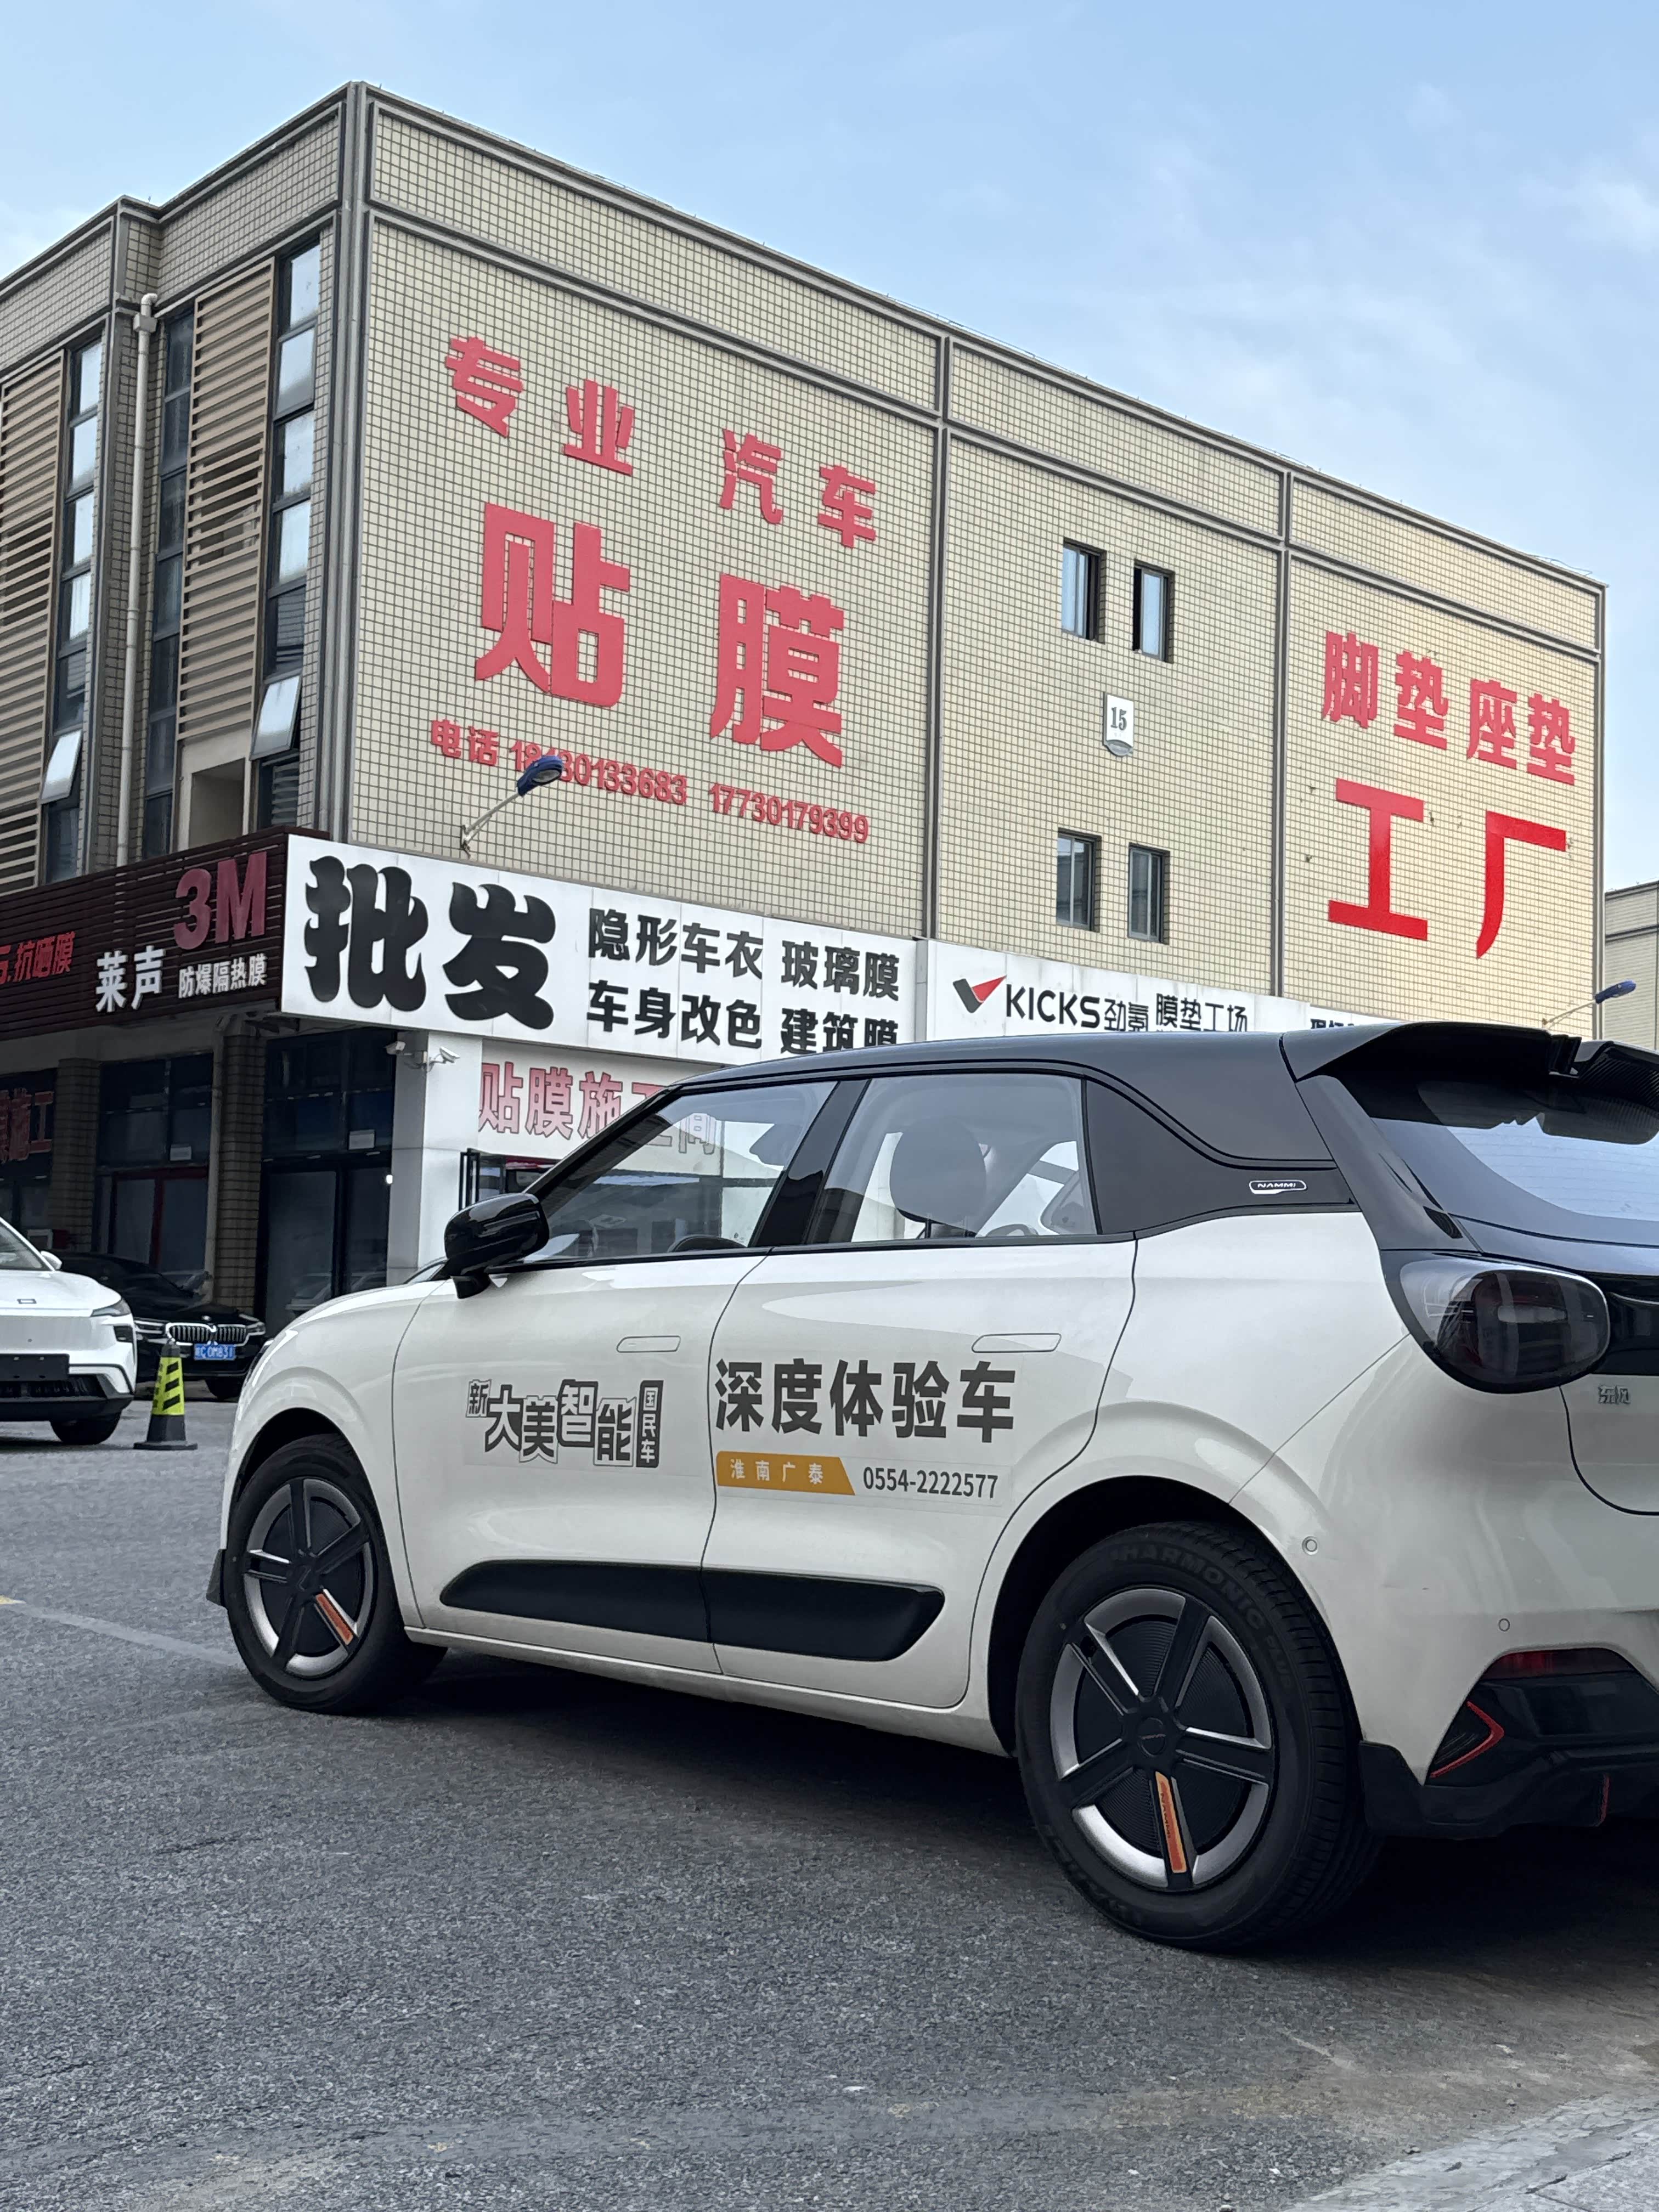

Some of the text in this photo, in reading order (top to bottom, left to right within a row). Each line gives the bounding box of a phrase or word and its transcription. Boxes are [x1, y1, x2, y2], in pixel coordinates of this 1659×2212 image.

[475, 502, 845, 768] 贴膜
[1110, 707, 1127, 731] 15
[1322, 631, 1575, 786] 脚垫座垫
[431, 719, 869, 844] 电话 1830133683 17730179399
[173, 851, 268, 950] 3M
[1328, 778, 1566, 959] 工厂
[95, 945, 167, 1013] 莱声
[178, 952, 268, 999] 防爆隔热膜
[304, 856, 556, 1030] 批发
[588, 908, 900, 1002] 隐形车衣 玻璃膜
[586, 979, 762, 1050] 车身改色
[1006, 984, 1101, 1029] KICKS
[715, 1358, 1015, 1443] 深度体验车
[729, 1458, 824, 1485] 淮南广泰
[863, 1466, 998, 1499] 0554-2222577
